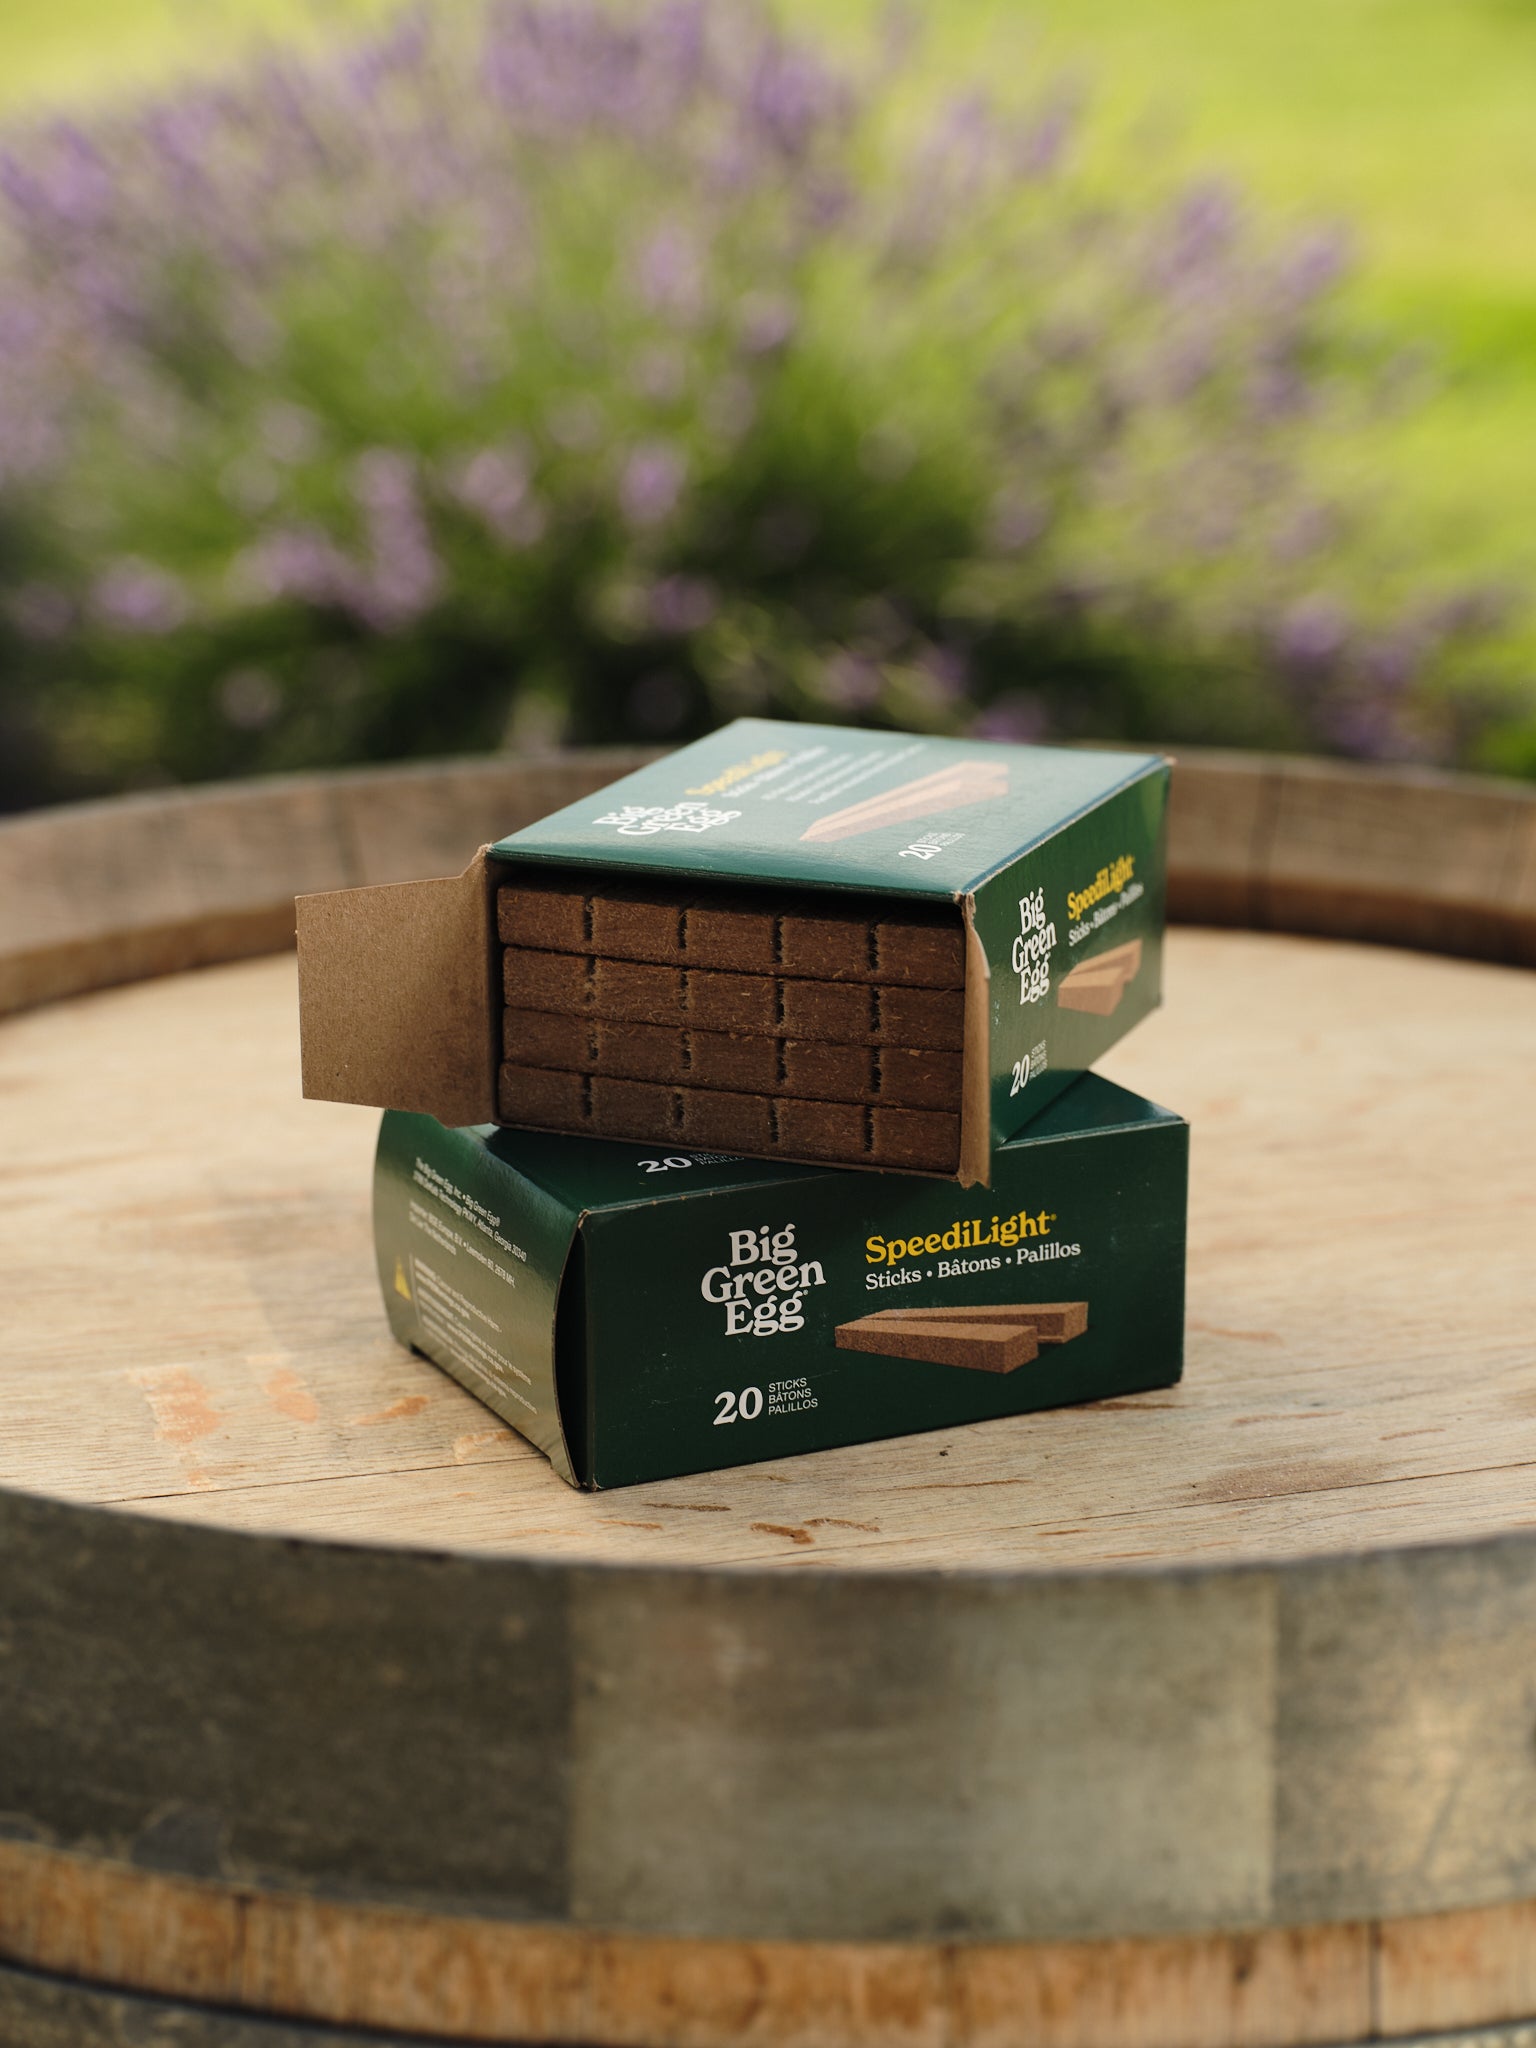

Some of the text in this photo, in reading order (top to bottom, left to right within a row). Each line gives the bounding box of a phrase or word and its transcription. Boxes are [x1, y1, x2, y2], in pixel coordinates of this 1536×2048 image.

[591, 806, 666, 826] Big
[617, 802, 709, 835] Green
[664, 810, 742, 833] Egg
[898, 844, 942, 860] 20
[1018, 886, 1046, 935] Big
[1012, 922, 1057, 973] Green
[1019, 951, 1050, 1005] Egg
[1009, 1054, 1030, 1097] 20
[637, 1157, 692, 1173] 20
[494, 1231, 512, 1252] Georgia
[728, 1223, 798, 1267] Big
[865, 1210, 1052, 1267] SpeediLight
[701, 1260, 827, 1303] Green
[865, 1241, 1082, 1291] Sticks Bâtons Palillos
[724, 1290, 805, 1337] Egg
[768, 1377, 807, 1393] STICKS
[768, 1387, 812, 1405] BÂTONS
[712, 1386, 764, 1426] 20
[768, 1398, 818, 1416] PALILLOS
